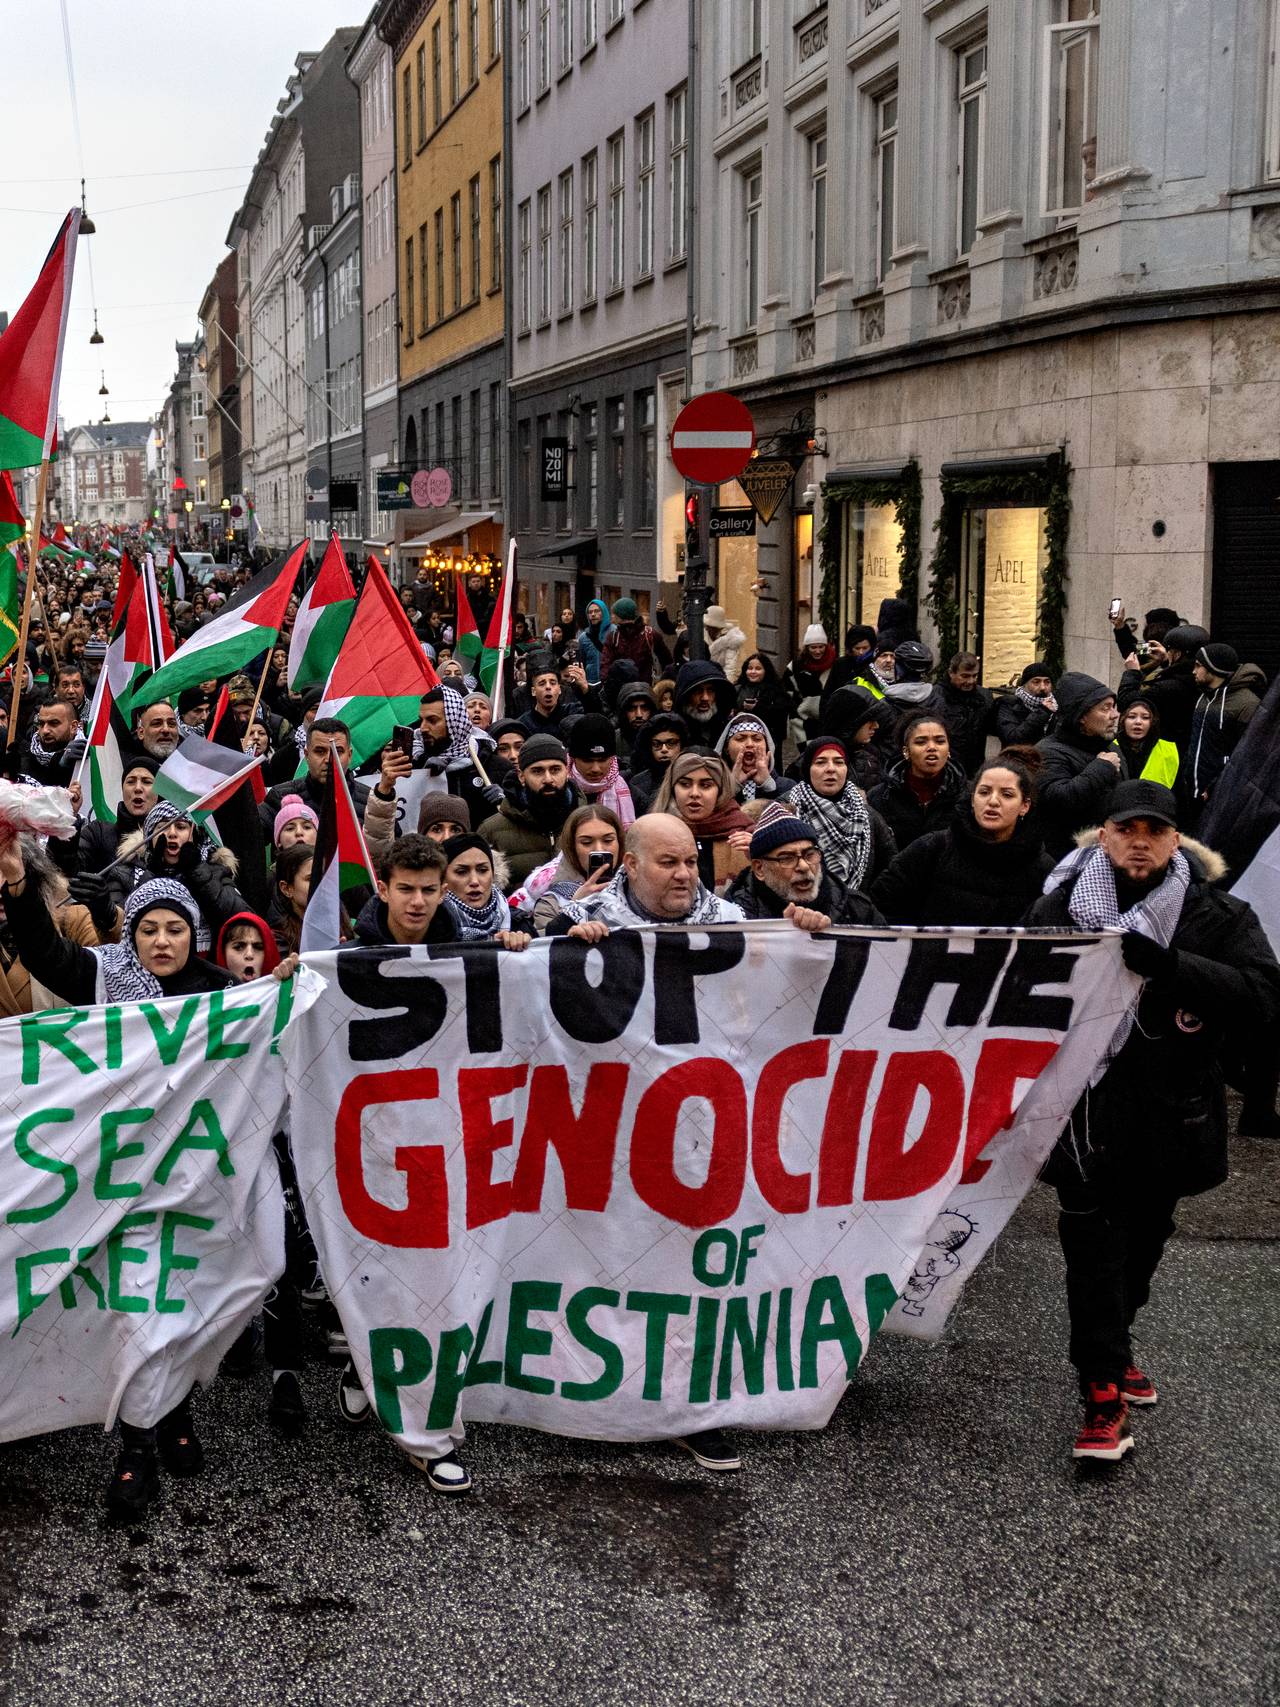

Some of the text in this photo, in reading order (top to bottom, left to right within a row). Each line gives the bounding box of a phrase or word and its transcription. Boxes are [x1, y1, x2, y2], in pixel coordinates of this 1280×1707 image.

[546, 448, 561, 458] NO
[546, 459, 561, 470] ZO
[546, 471, 561, 481] MI
[746, 479, 787, 491] JUVELER
[710, 518, 753, 531] Gallery
[337, 929, 1101, 1061] STOP THE
[6, 1098, 236, 1225] SEA
[334, 1037, 1061, 1250] GENOCIDE
[11, 1210, 215, 1338] FREE
[692, 1224, 766, 1288] OF
